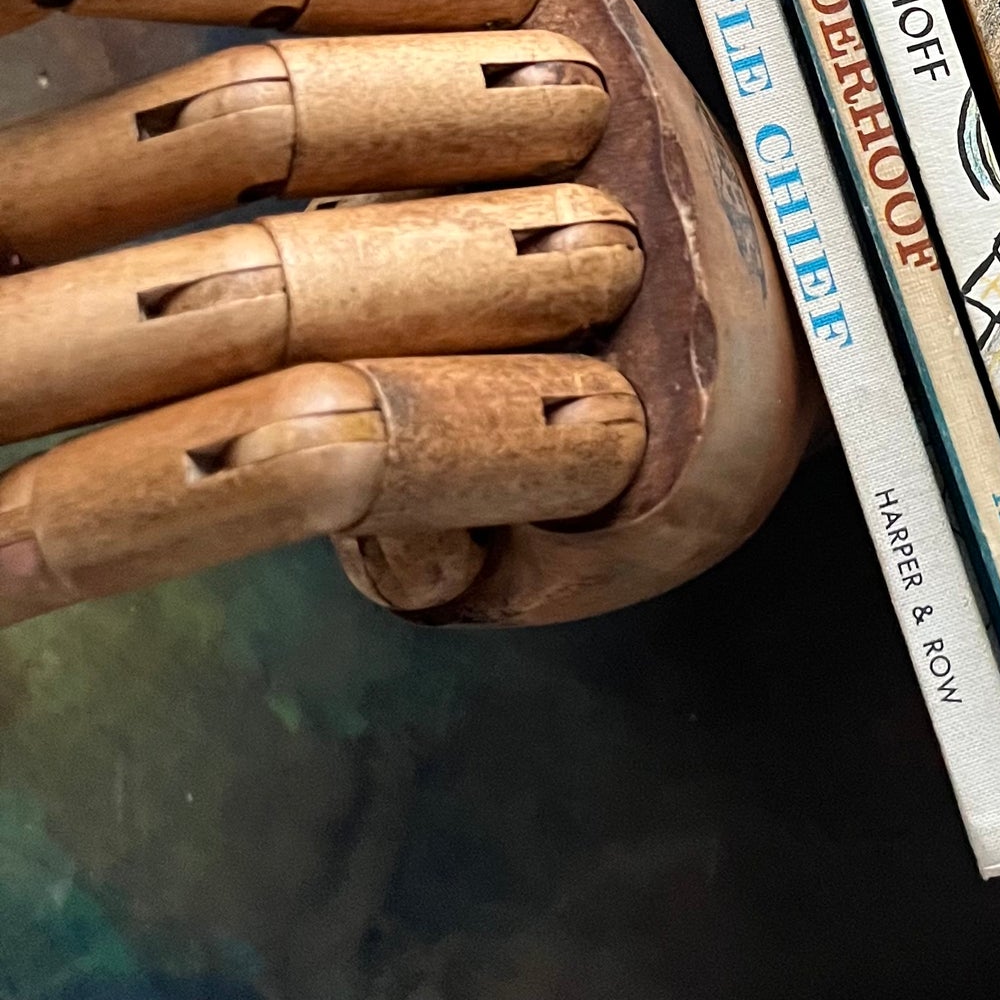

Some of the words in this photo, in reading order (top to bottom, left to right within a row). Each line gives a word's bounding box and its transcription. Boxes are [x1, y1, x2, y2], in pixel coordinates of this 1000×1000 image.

[754, 122, 853, 349] CHIEF
[874, 487, 923, 590] HARPER
[912, 604, 934, 625] &
[923, 637, 963, 705] ROW
